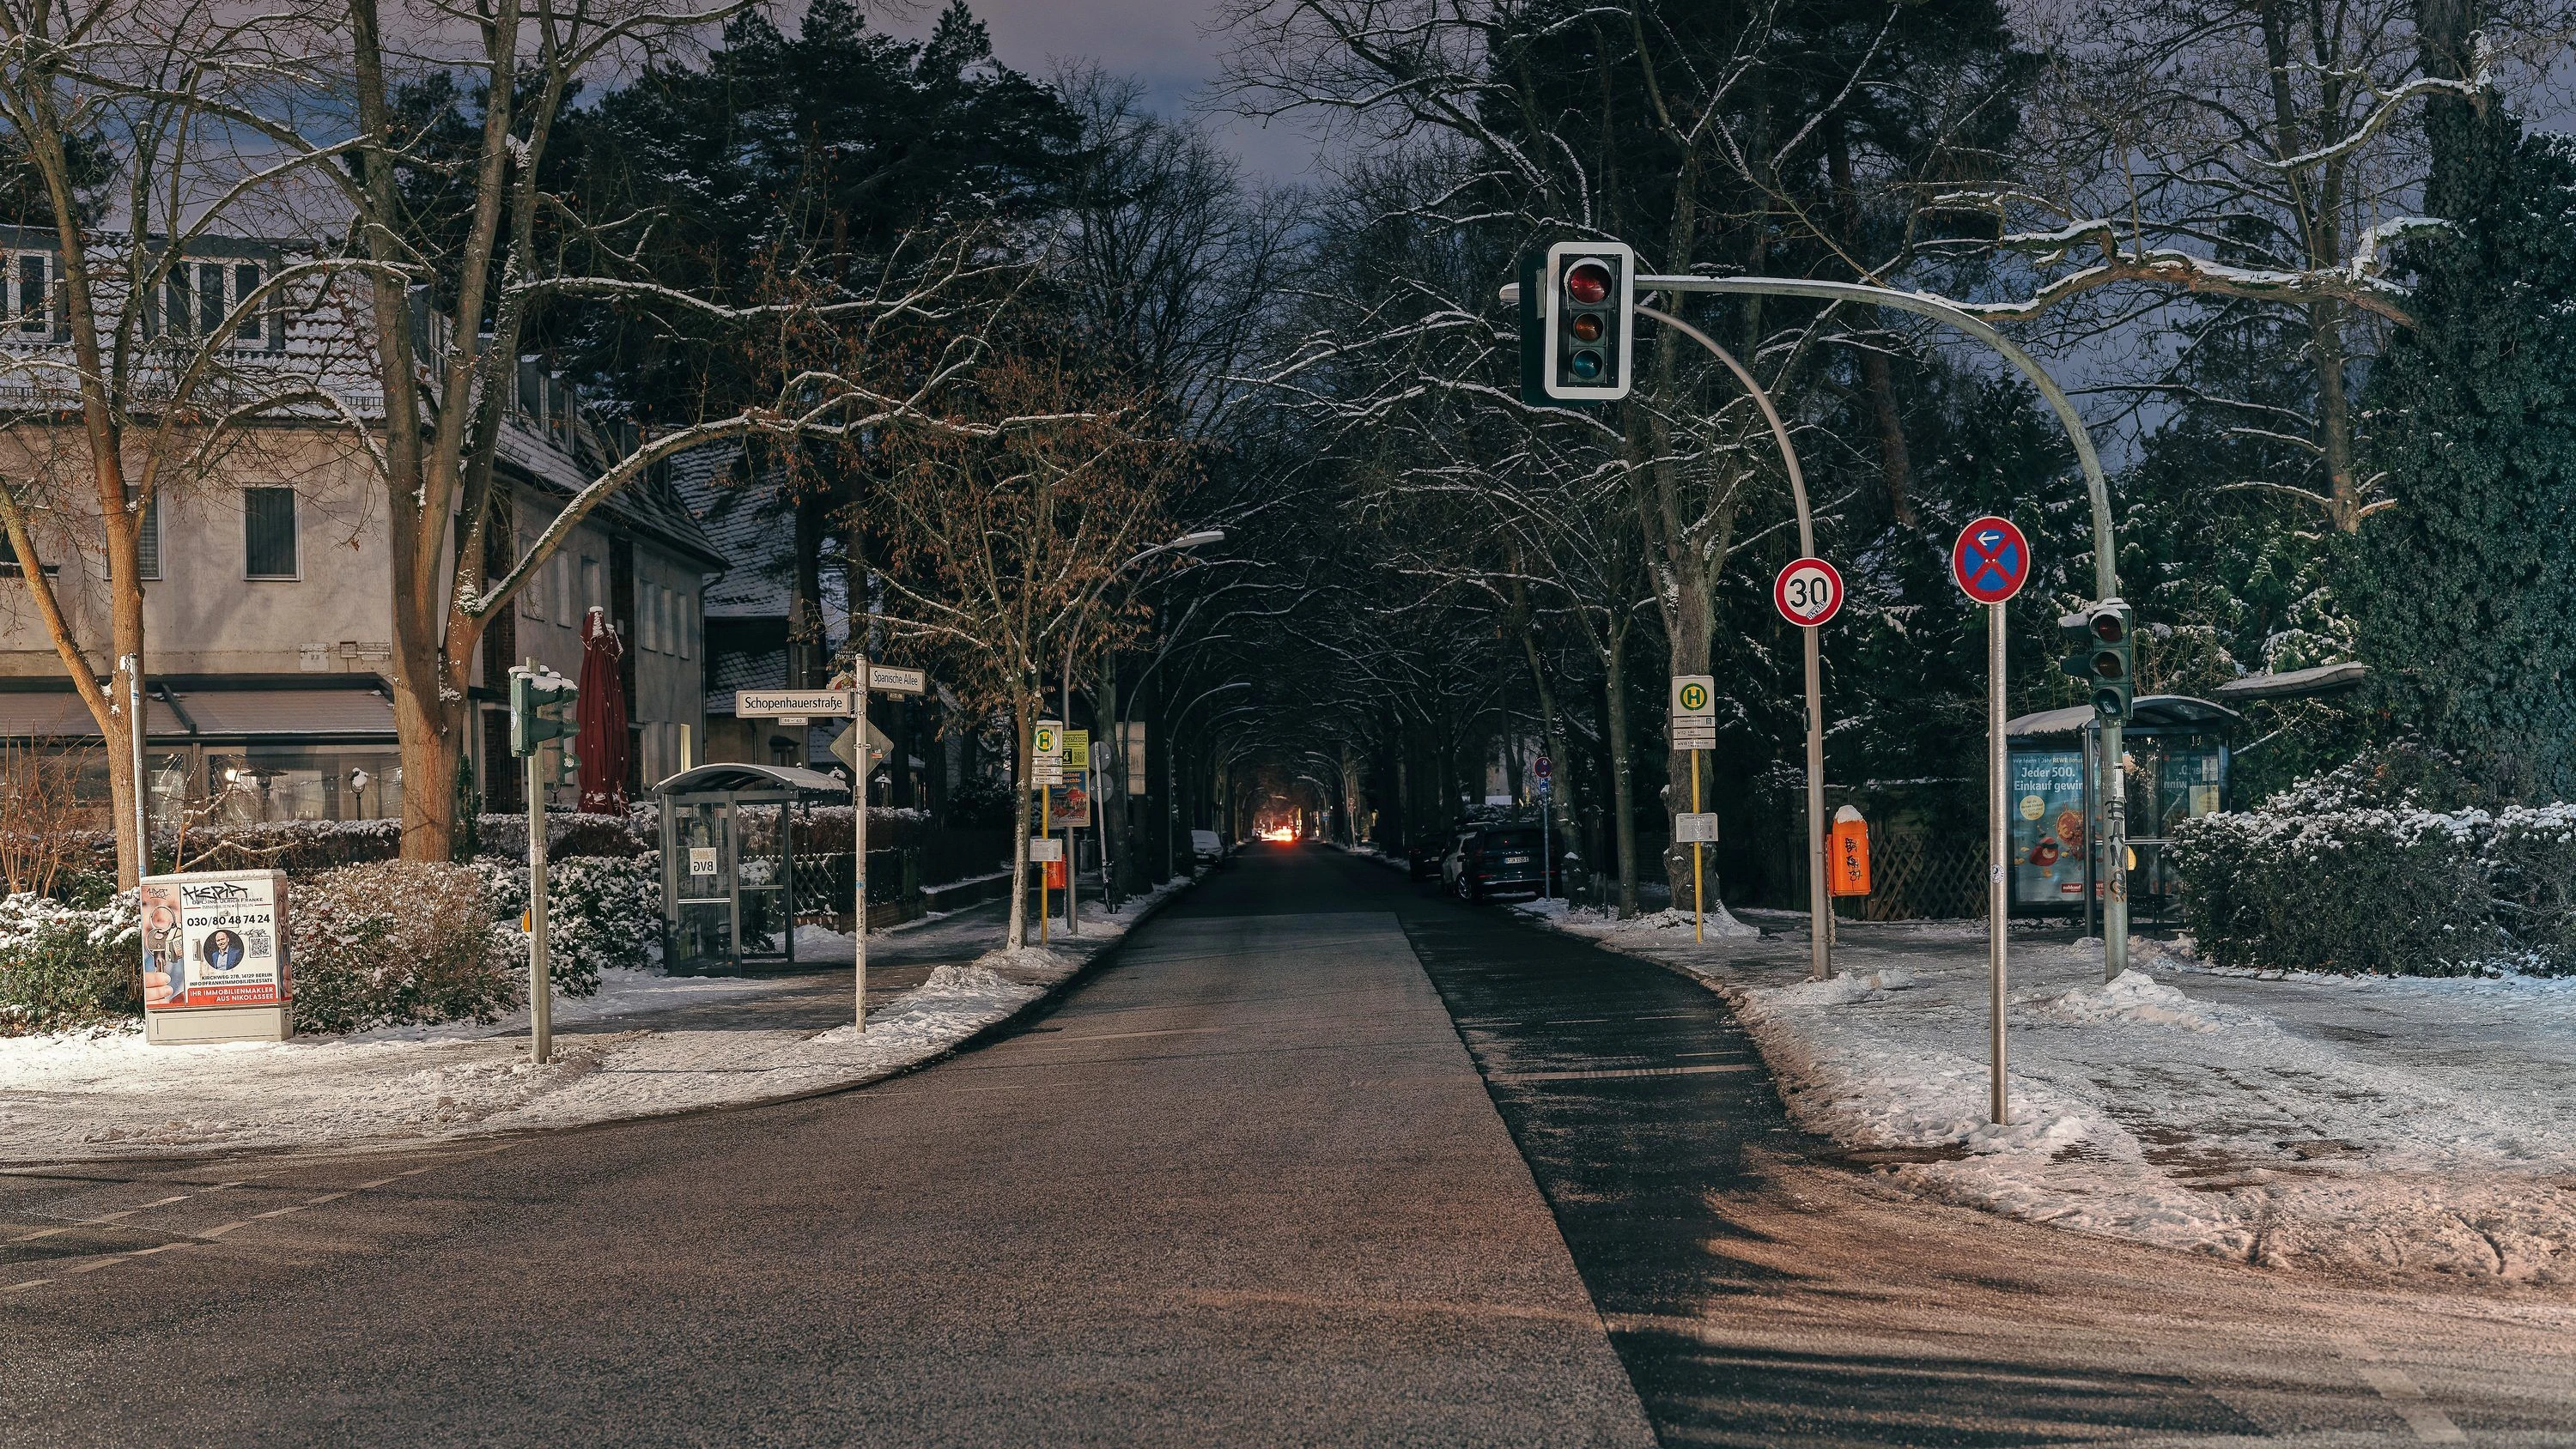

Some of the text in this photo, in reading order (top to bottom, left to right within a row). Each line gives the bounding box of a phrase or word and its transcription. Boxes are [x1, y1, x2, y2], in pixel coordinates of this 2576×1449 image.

[1789, 578, 1828, 608] 30
[874, 670, 918, 686] Spanische Allee
[744, 696, 842, 711] Schopenhauerstraße
[2021, 767, 2075, 777] Jeder 500.
[2014, 780, 2052, 791] Einkauf
[187, 914, 270, 927] 030/80 48 74 24
[204, 987, 273, 995] IMMOBILIENMAKLER
